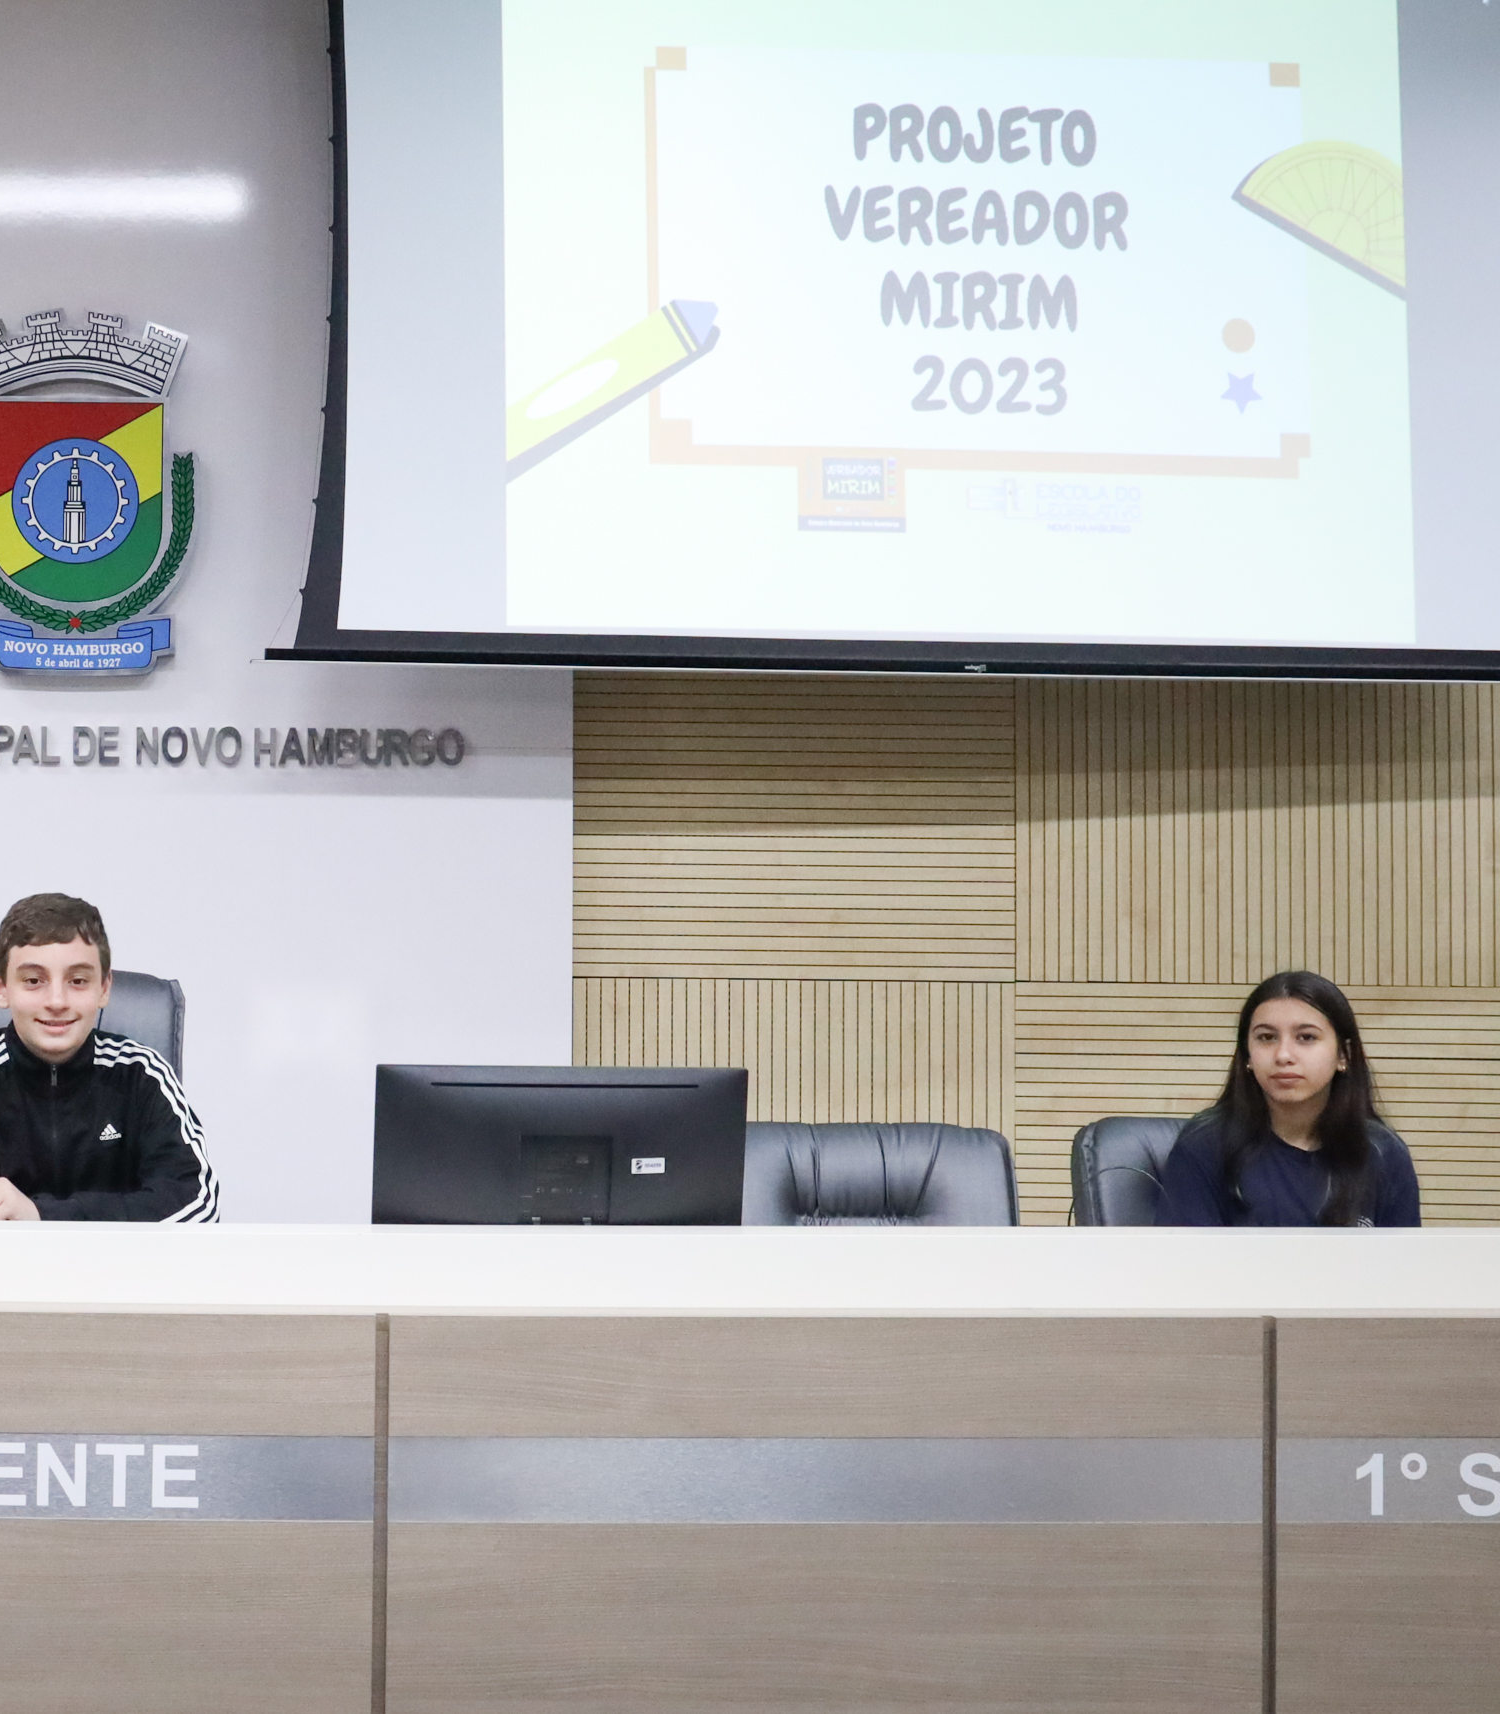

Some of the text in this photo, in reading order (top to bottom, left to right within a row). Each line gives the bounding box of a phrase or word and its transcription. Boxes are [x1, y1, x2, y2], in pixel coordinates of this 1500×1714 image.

[853, 102, 1097, 167] PROJETO
[823, 184, 1129, 251] VEREADOR
[880, 269, 1078, 332] MIRIM
[911, 355, 1068, 416] 2023
[825, 464, 882, 477] VEREADOR
[827, 479, 881, 495] MIRIM
[1035, 483, 1142, 502] ESCOLA DO
[3, 640, 144, 656] NOVO HAMBURGO
[35, 657, 121, 668] 5 de abril de 1927
[73, 726, 120, 766] DE
[135, 726, 242, 767] NOVO
[253, 727, 465, 768] HAMBURGO
[99, 1132, 122, 1141] adidas
